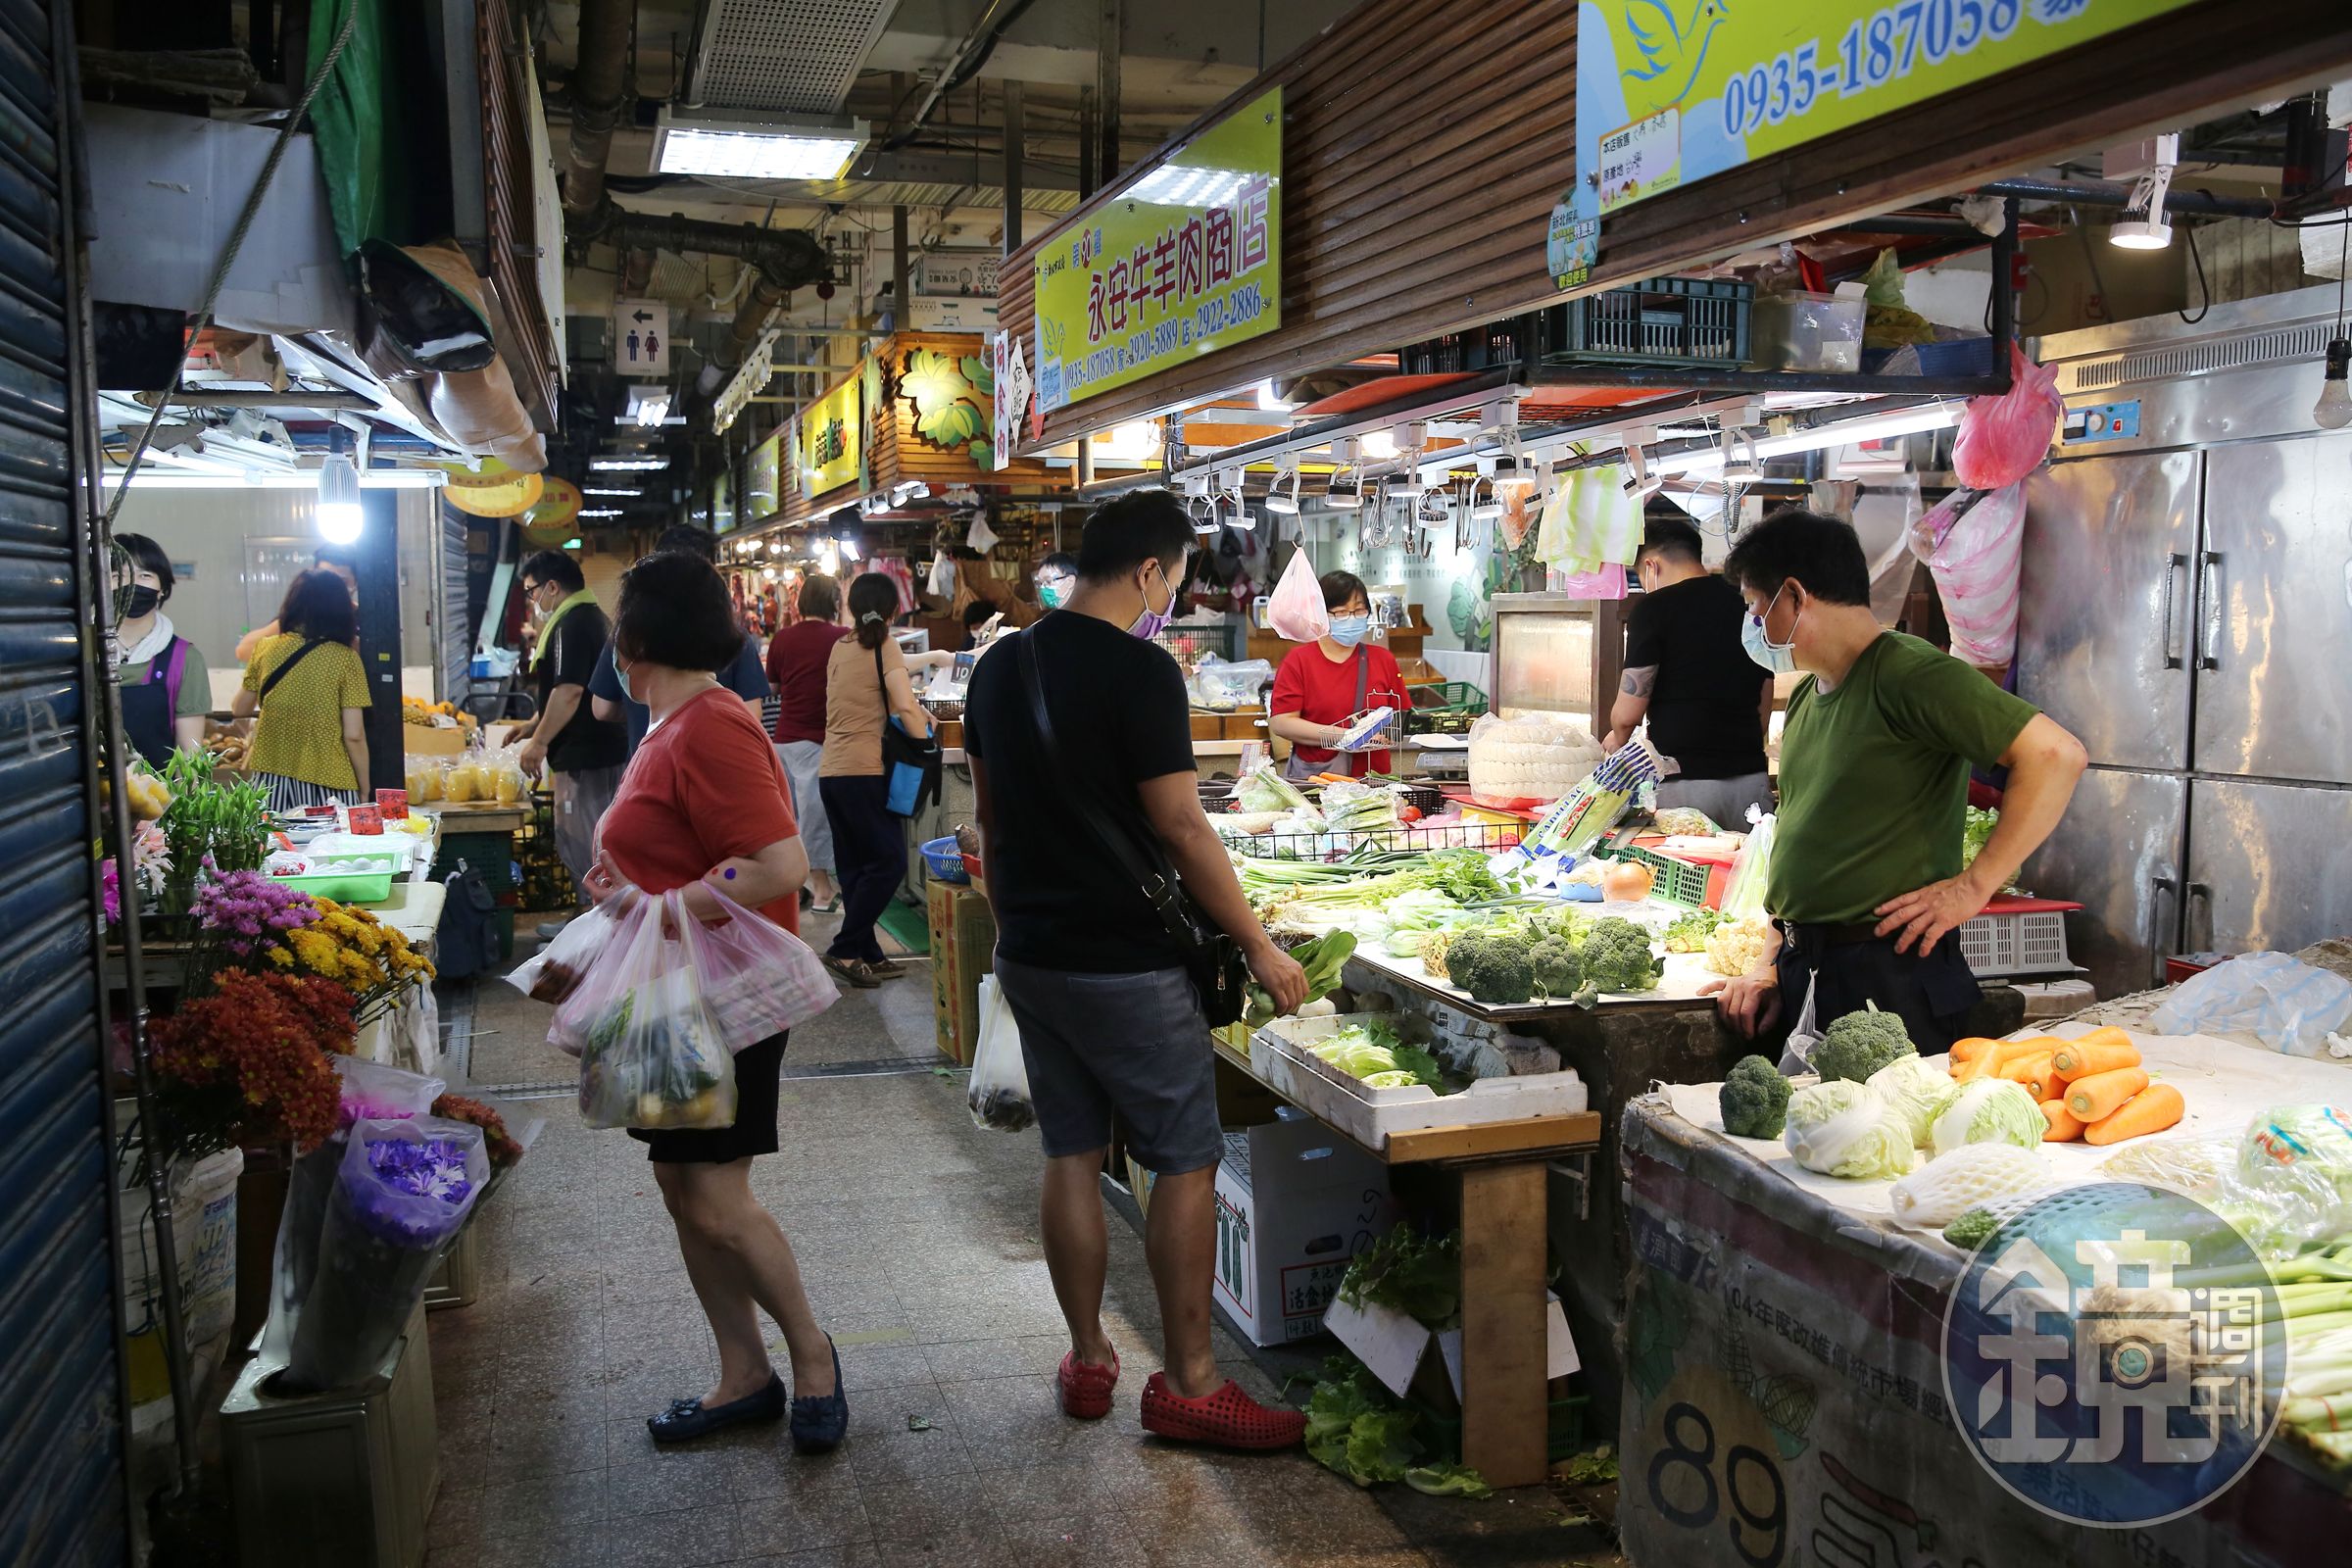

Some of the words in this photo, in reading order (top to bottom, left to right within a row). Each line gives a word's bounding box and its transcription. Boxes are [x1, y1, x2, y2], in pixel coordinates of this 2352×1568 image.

[1088, 174, 1268, 342] 永安牛羊肉商店
[1558, 268, 1588, 289] 歡迎使用
[1647, 1401, 1788, 1568] 89
